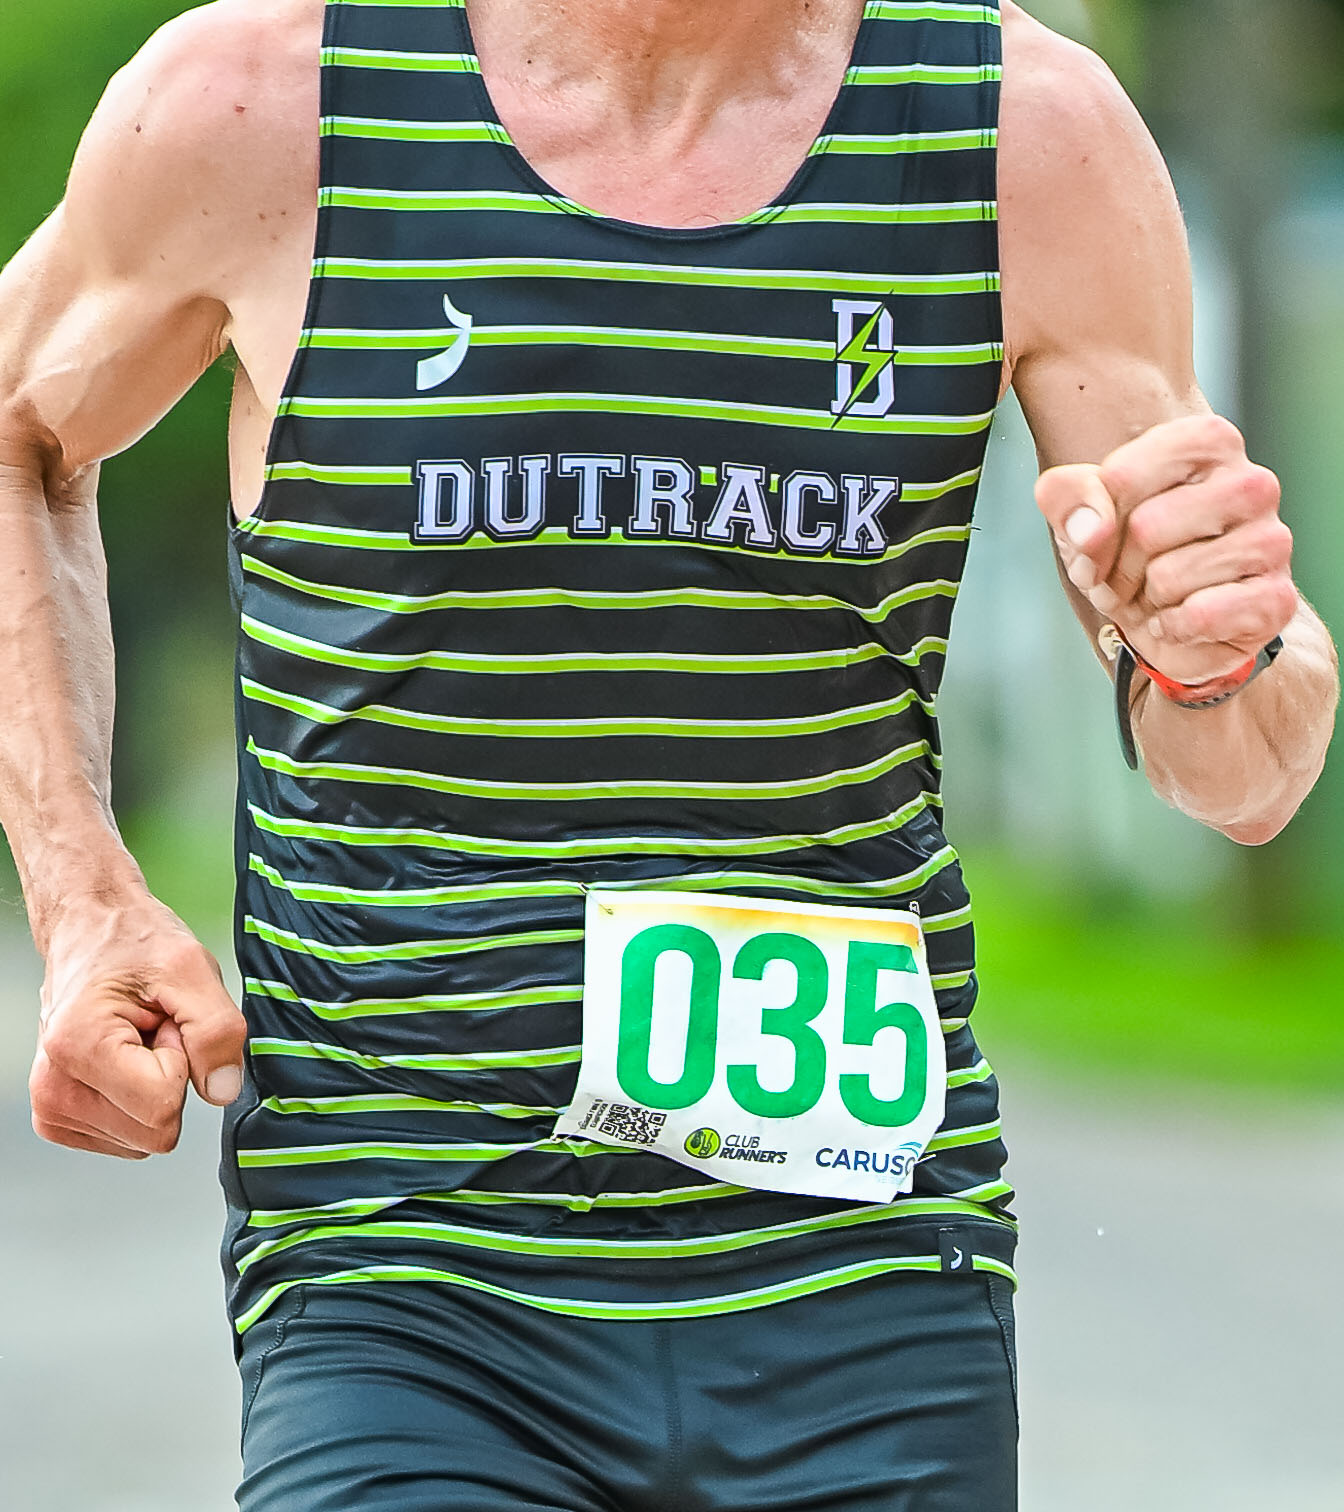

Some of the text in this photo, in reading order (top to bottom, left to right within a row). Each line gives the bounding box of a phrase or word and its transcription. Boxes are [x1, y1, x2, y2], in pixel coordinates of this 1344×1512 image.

[415, 454, 900, 554] DUTRACK
[617, 923, 927, 1128] 035
[725, 1134, 760, 1148] CLUB
